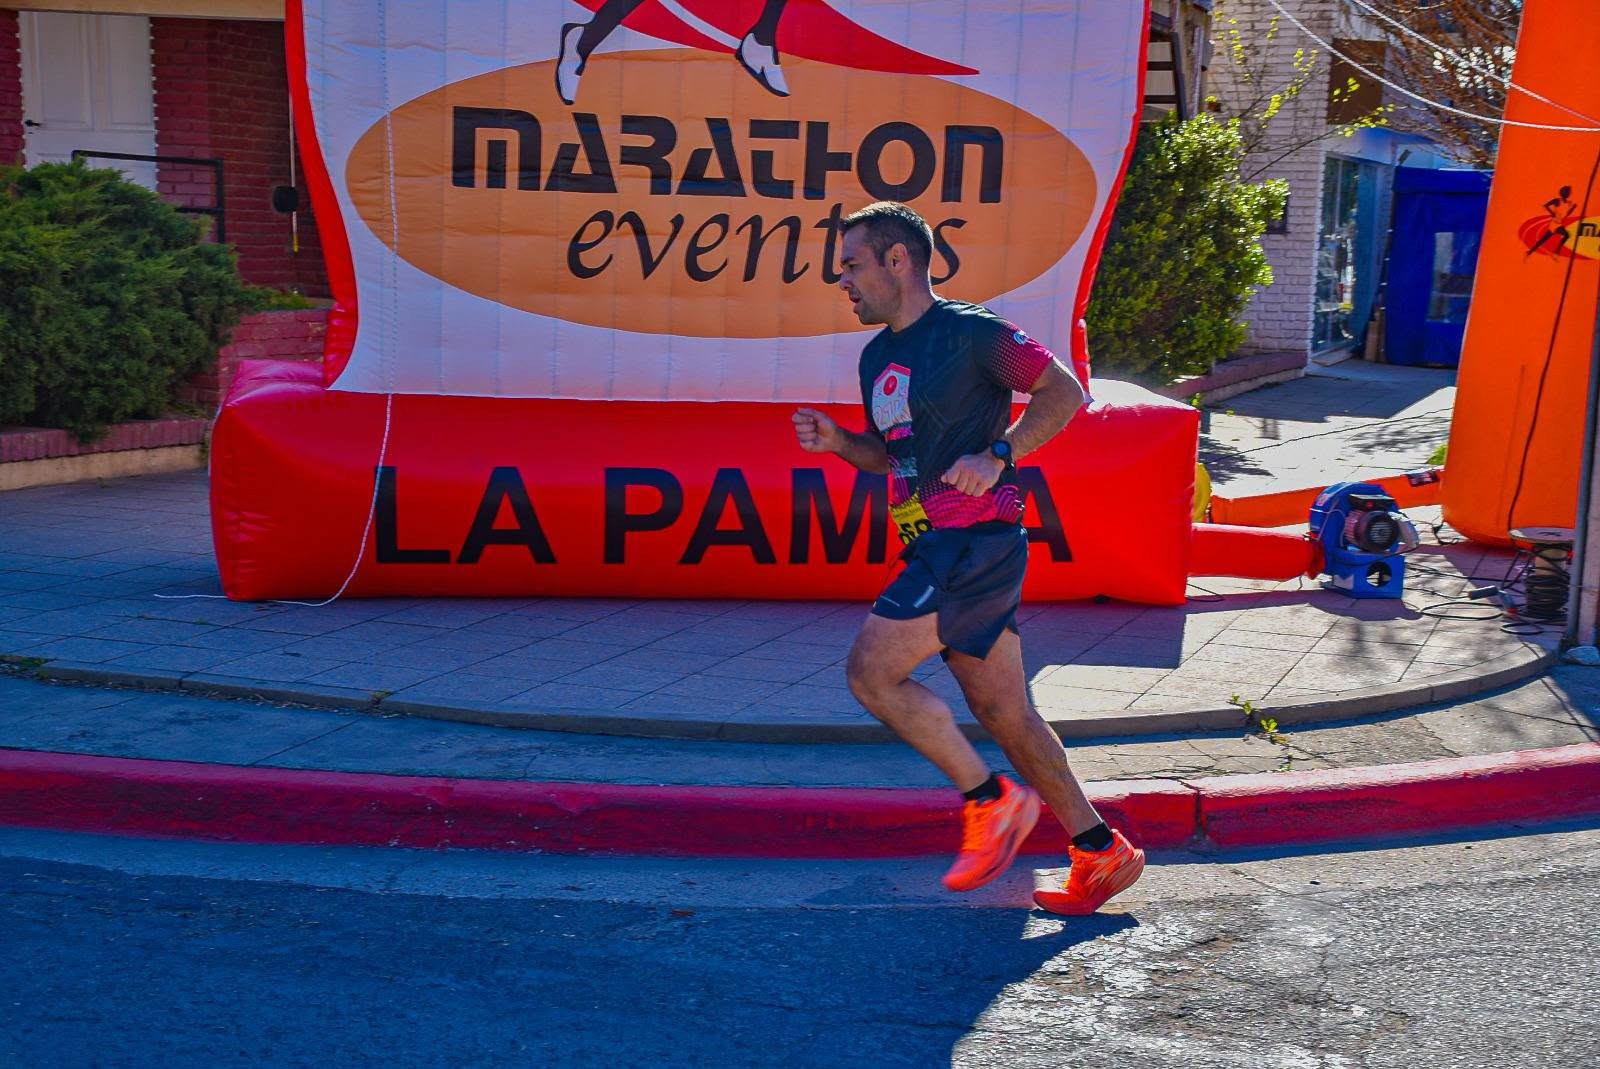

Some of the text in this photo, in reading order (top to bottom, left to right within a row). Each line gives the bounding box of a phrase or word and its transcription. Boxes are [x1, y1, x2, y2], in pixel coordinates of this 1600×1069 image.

[452, 105, 1004, 205] MARATHON
[567, 203, 967, 286] events
[1577, 222, 1600, 238] M
[374, 464, 1073, 565] LA PAMA
